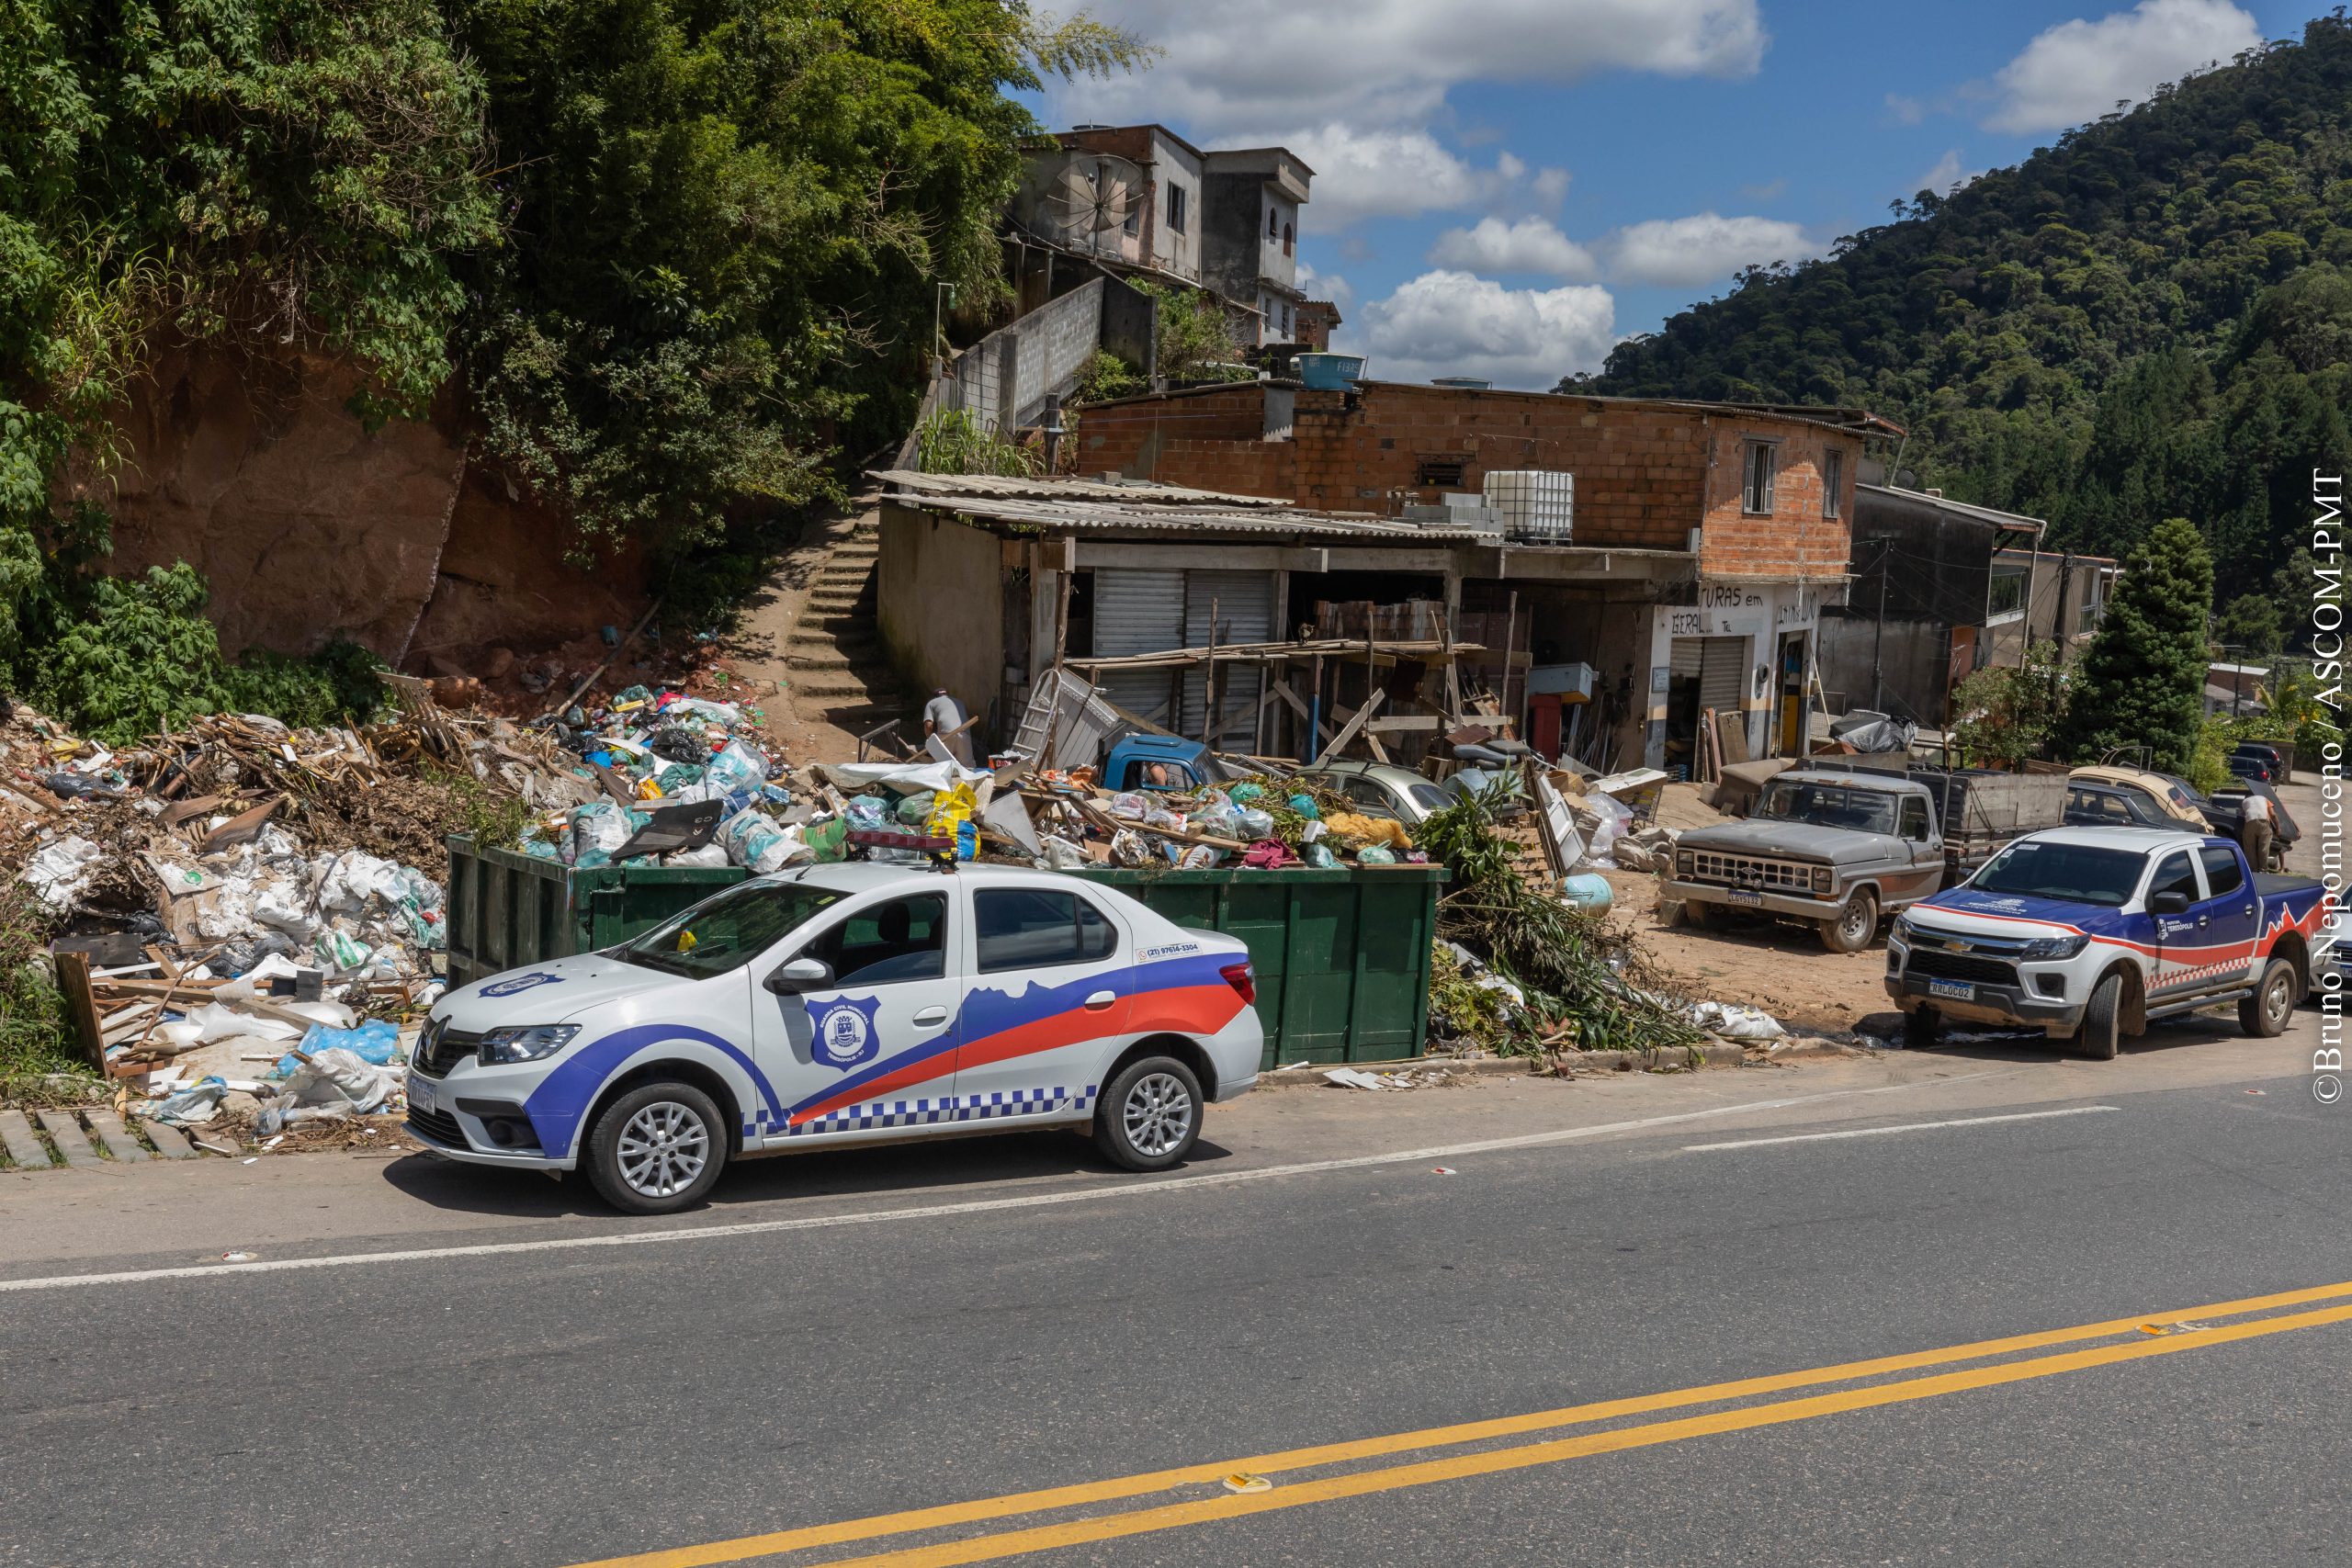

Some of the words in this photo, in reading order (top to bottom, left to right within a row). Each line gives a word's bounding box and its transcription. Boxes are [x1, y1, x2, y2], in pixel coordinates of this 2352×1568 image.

[1746, 594, 1763, 607] em
[1160, 944, 1198, 954] 97614-3304
[847, 1005, 870, 1025] MUNICIPAL
